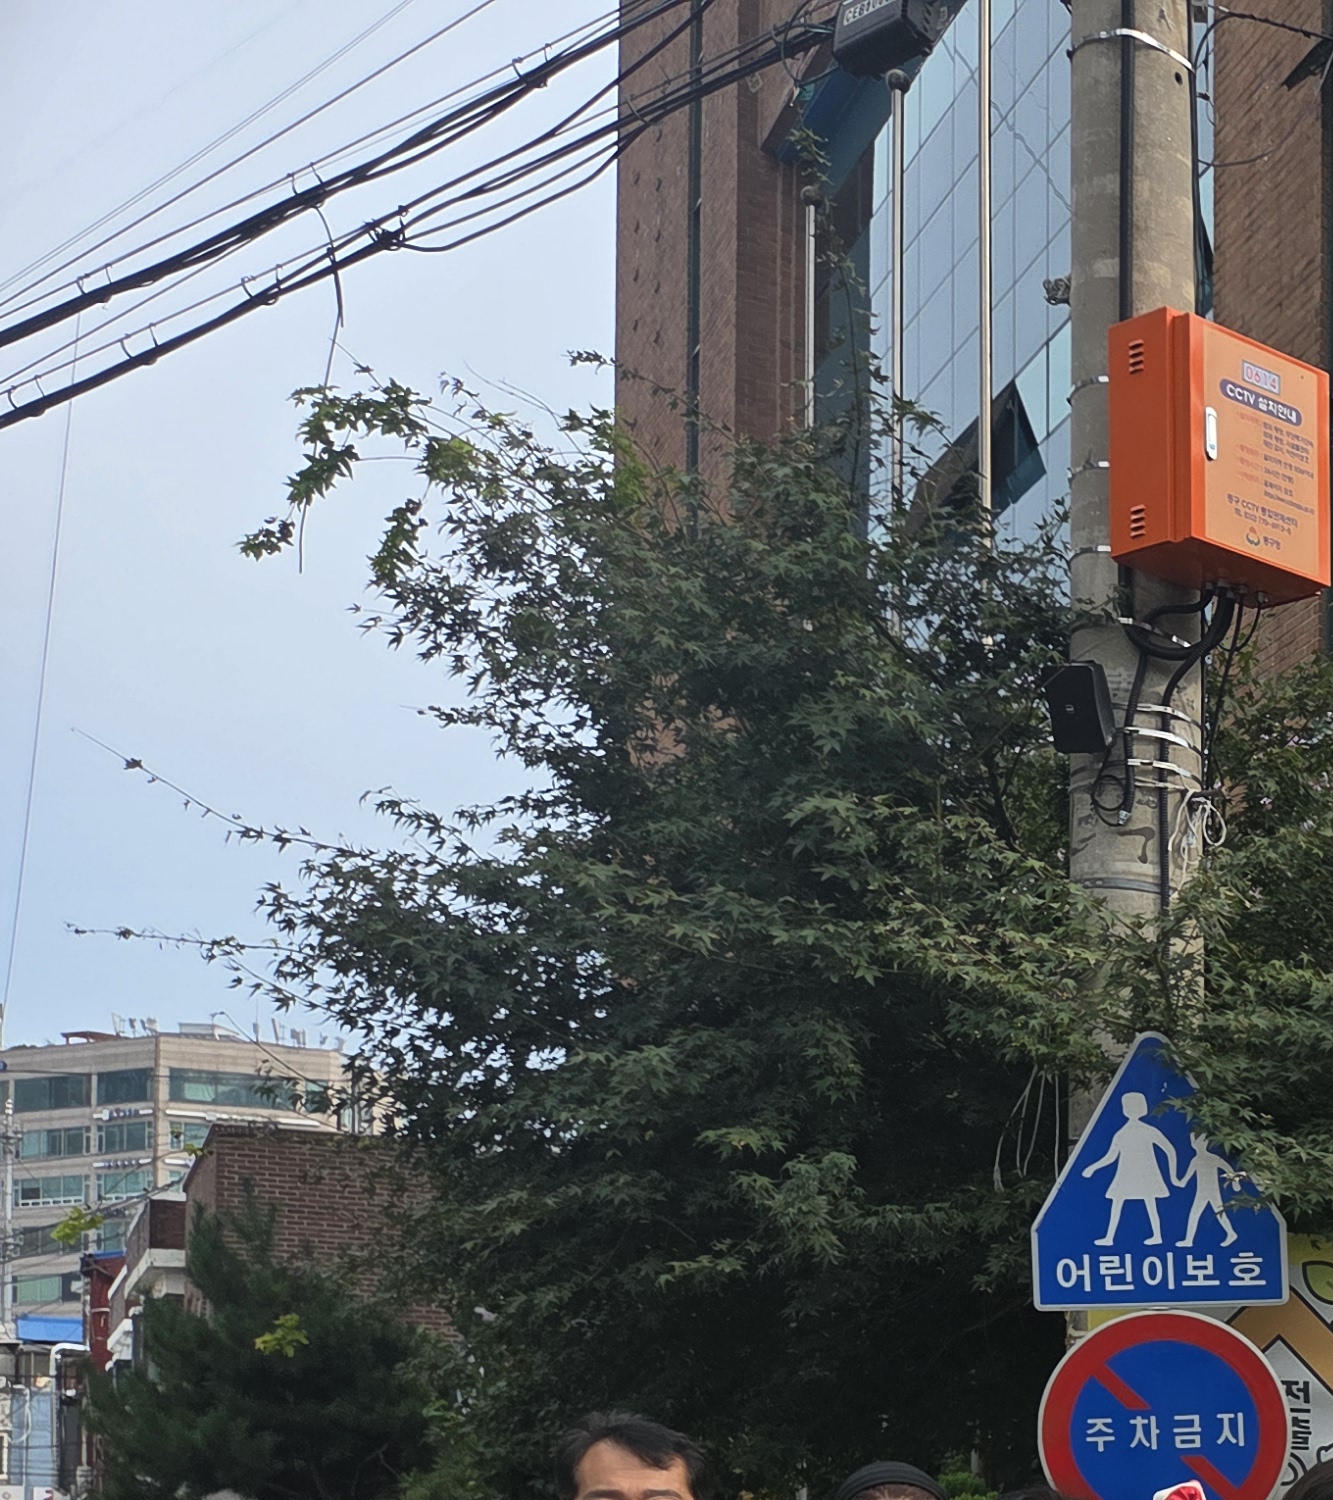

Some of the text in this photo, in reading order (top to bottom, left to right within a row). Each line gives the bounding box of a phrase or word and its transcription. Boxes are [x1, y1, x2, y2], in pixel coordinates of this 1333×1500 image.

[1226, 383, 1255, 405] CCTV
[1056, 1252, 1267, 1292] 어린이보호
[1086, 1412, 1246, 1452] 주차금지
